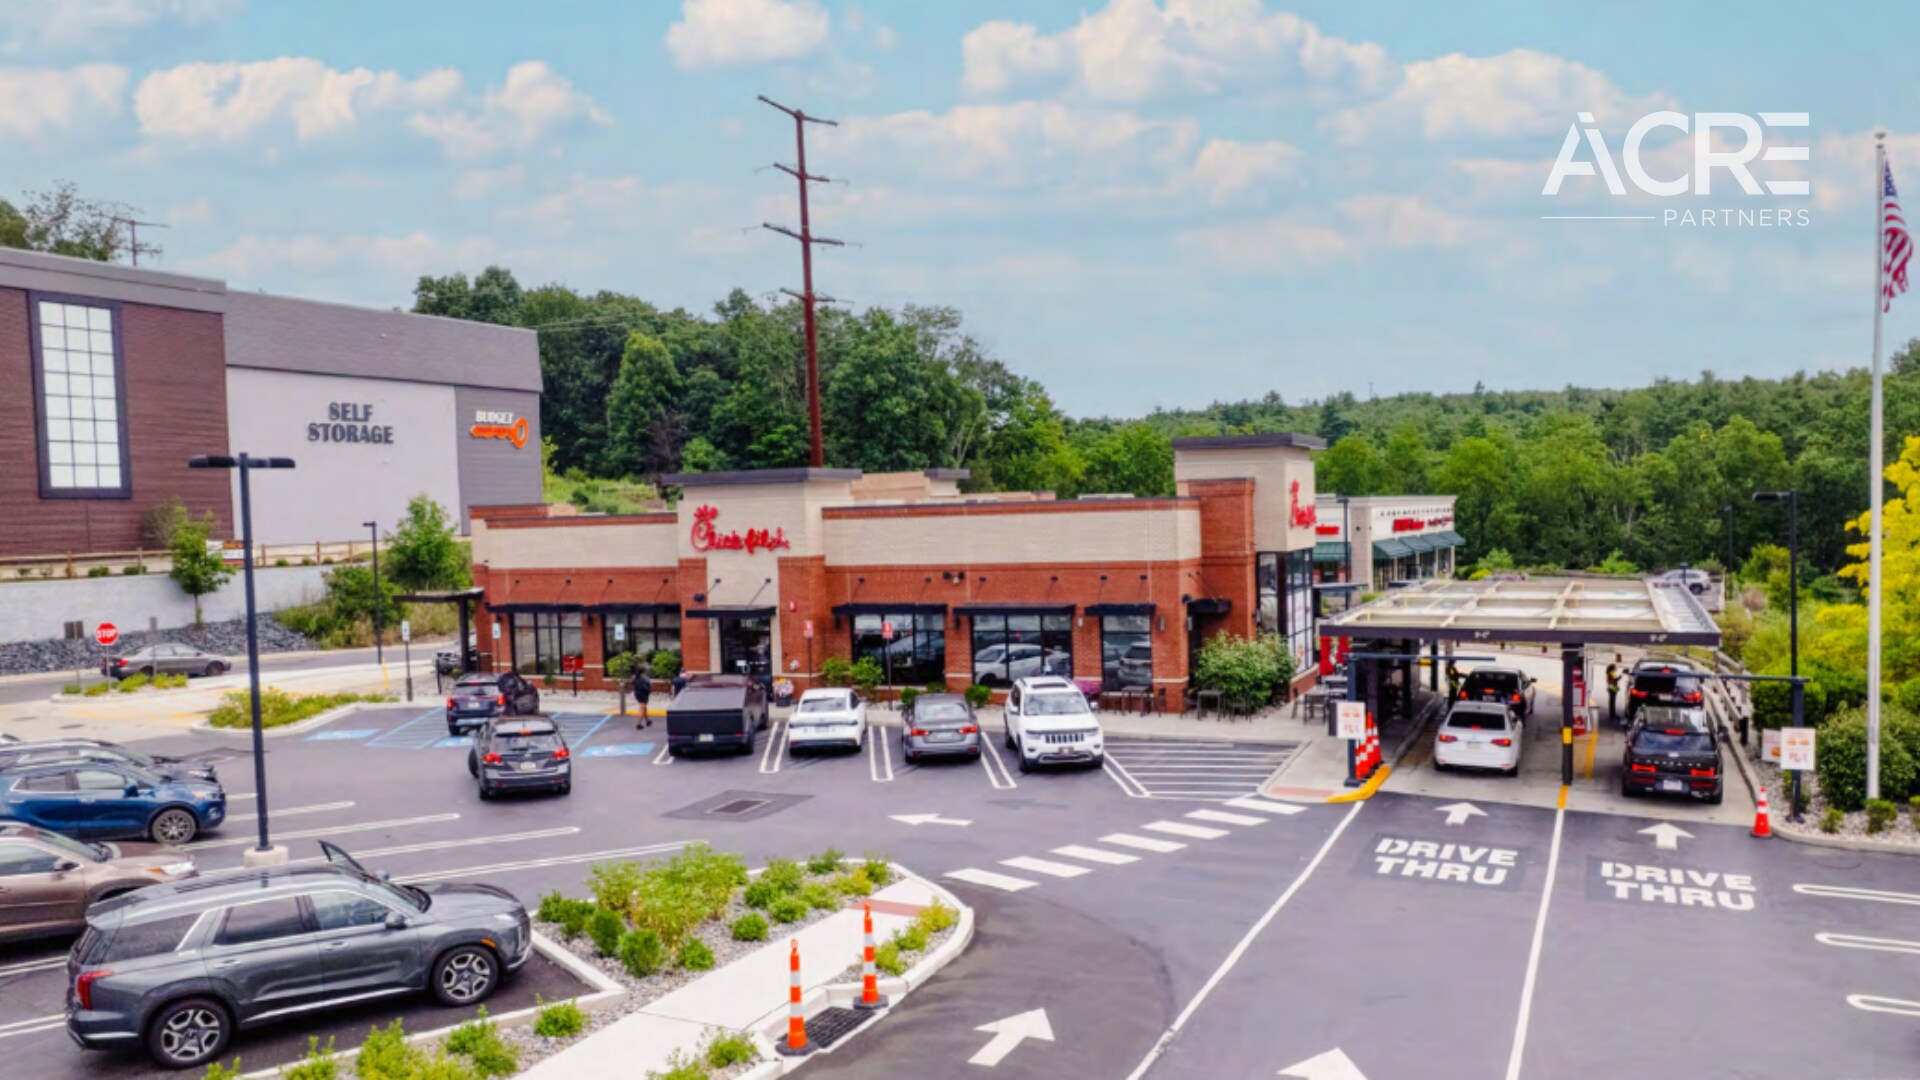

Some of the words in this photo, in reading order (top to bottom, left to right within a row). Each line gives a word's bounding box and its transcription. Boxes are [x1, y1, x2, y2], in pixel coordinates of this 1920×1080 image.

[328, 402, 374, 422] SELF
[308, 423, 394, 444] STORAGE
[97, 628, 118, 639] STOP
[1375, 838, 1518, 867] DRIVE
[1375, 856, 1508, 885] THRU
[1601, 861, 1757, 892] DRIVE
[1605, 880, 1755, 911] THRU
